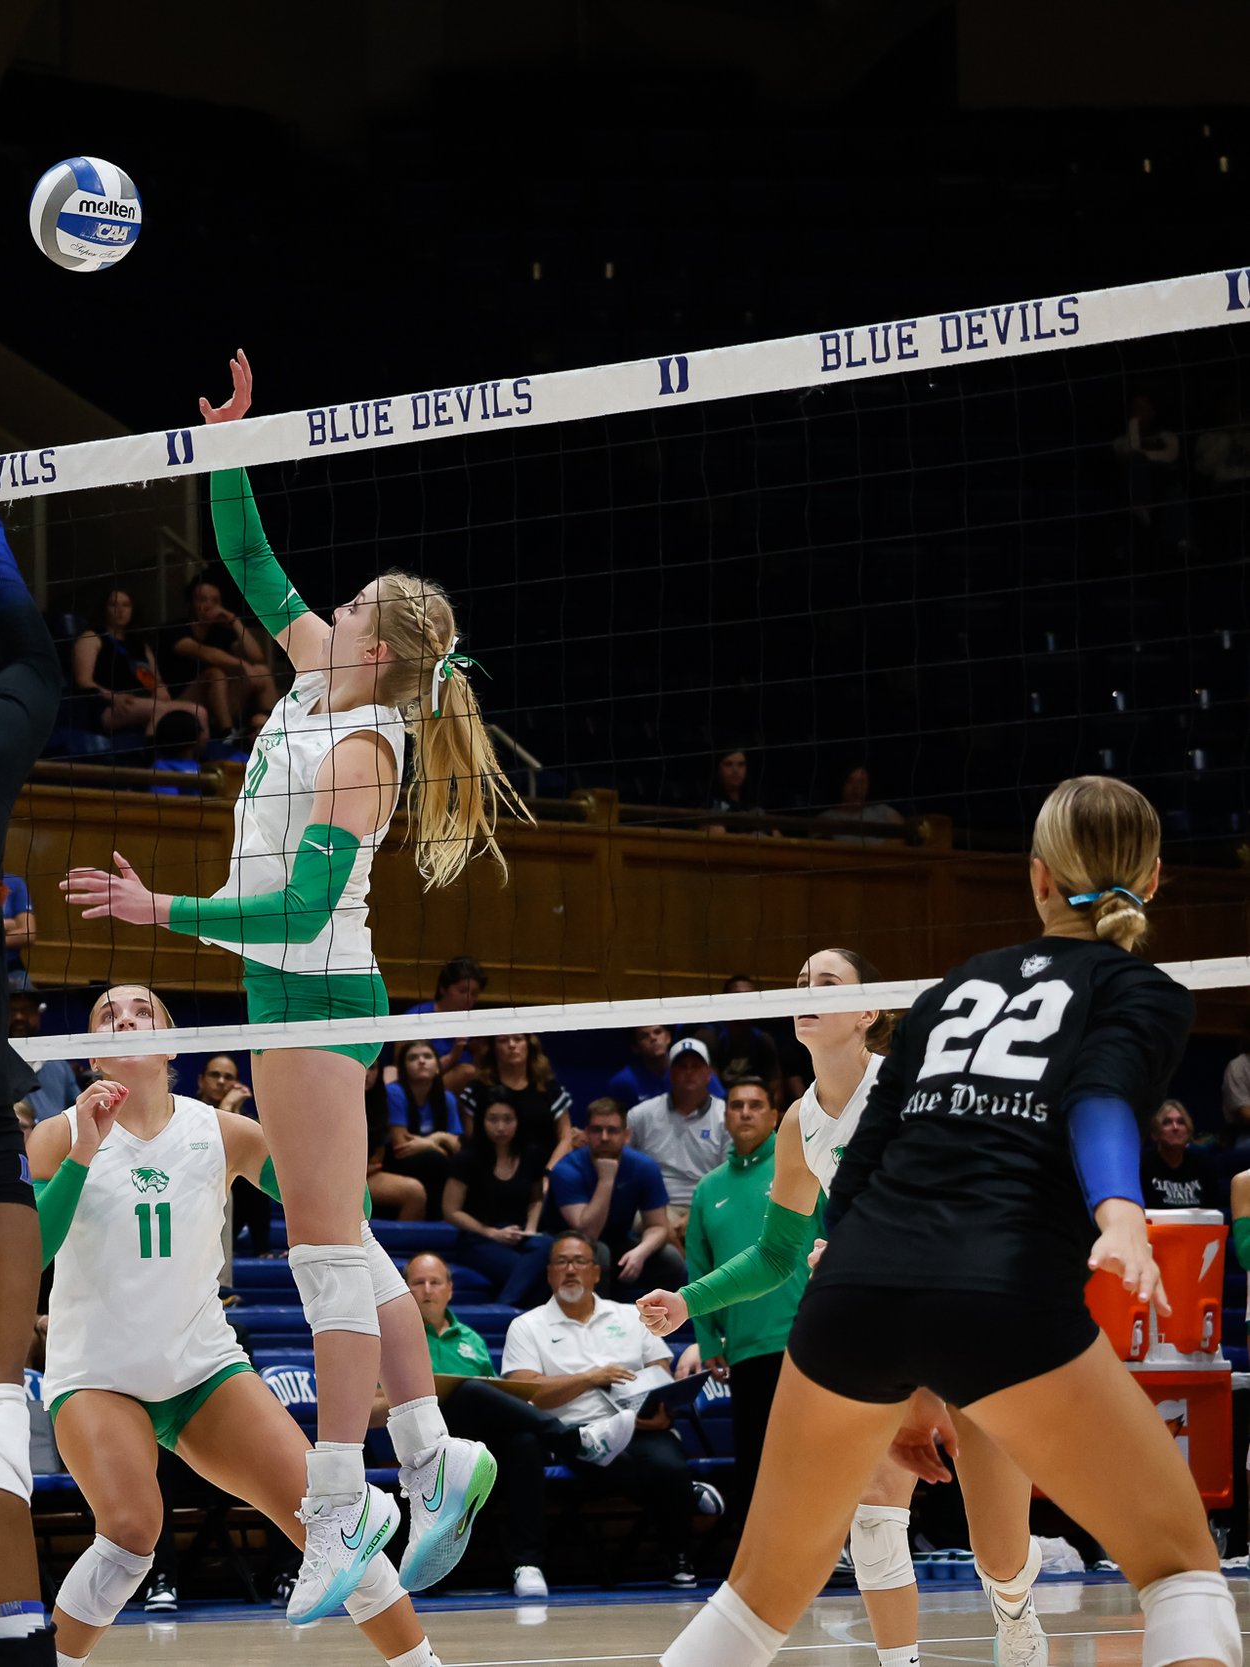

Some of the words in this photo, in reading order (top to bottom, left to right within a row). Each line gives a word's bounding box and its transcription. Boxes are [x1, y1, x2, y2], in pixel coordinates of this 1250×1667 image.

[78, 199, 136, 220] molten
[820, 320, 919, 372] BLUE
[940, 296, 1079, 354] DEVILS
[307, 399, 394, 446] BLUE
[411, 378, 533, 430] DEVILS
[916, 978, 1074, 1083] 22
[948, 1083, 1049, 1122] Devils
[134, 1201, 172, 1259] 11
[265, 1371, 317, 1407] DUK
